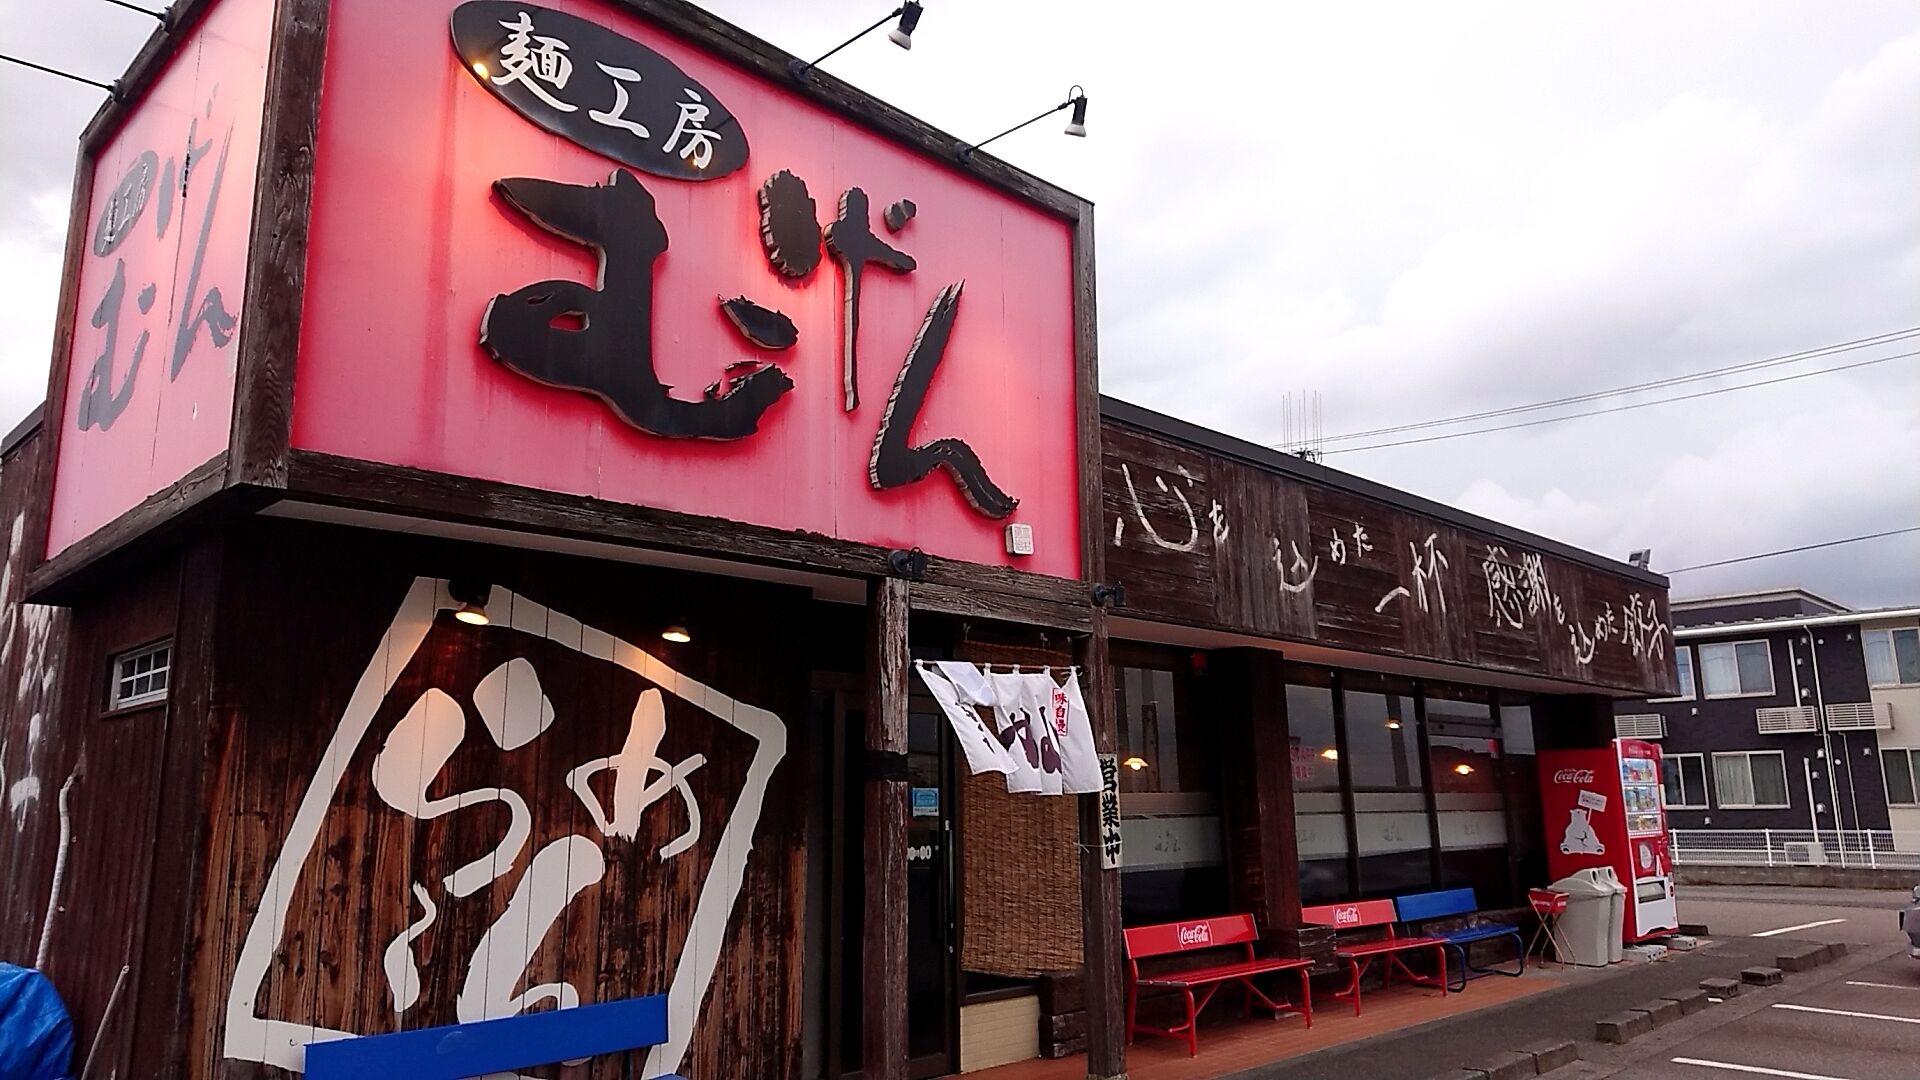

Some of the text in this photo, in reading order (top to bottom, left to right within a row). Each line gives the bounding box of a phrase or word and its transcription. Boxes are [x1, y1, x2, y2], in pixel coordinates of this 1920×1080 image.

[78, 82, 238, 432] むげん
[479, 167, 1020, 521] むげん
[1100, 758, 1121, 865] 営業中
